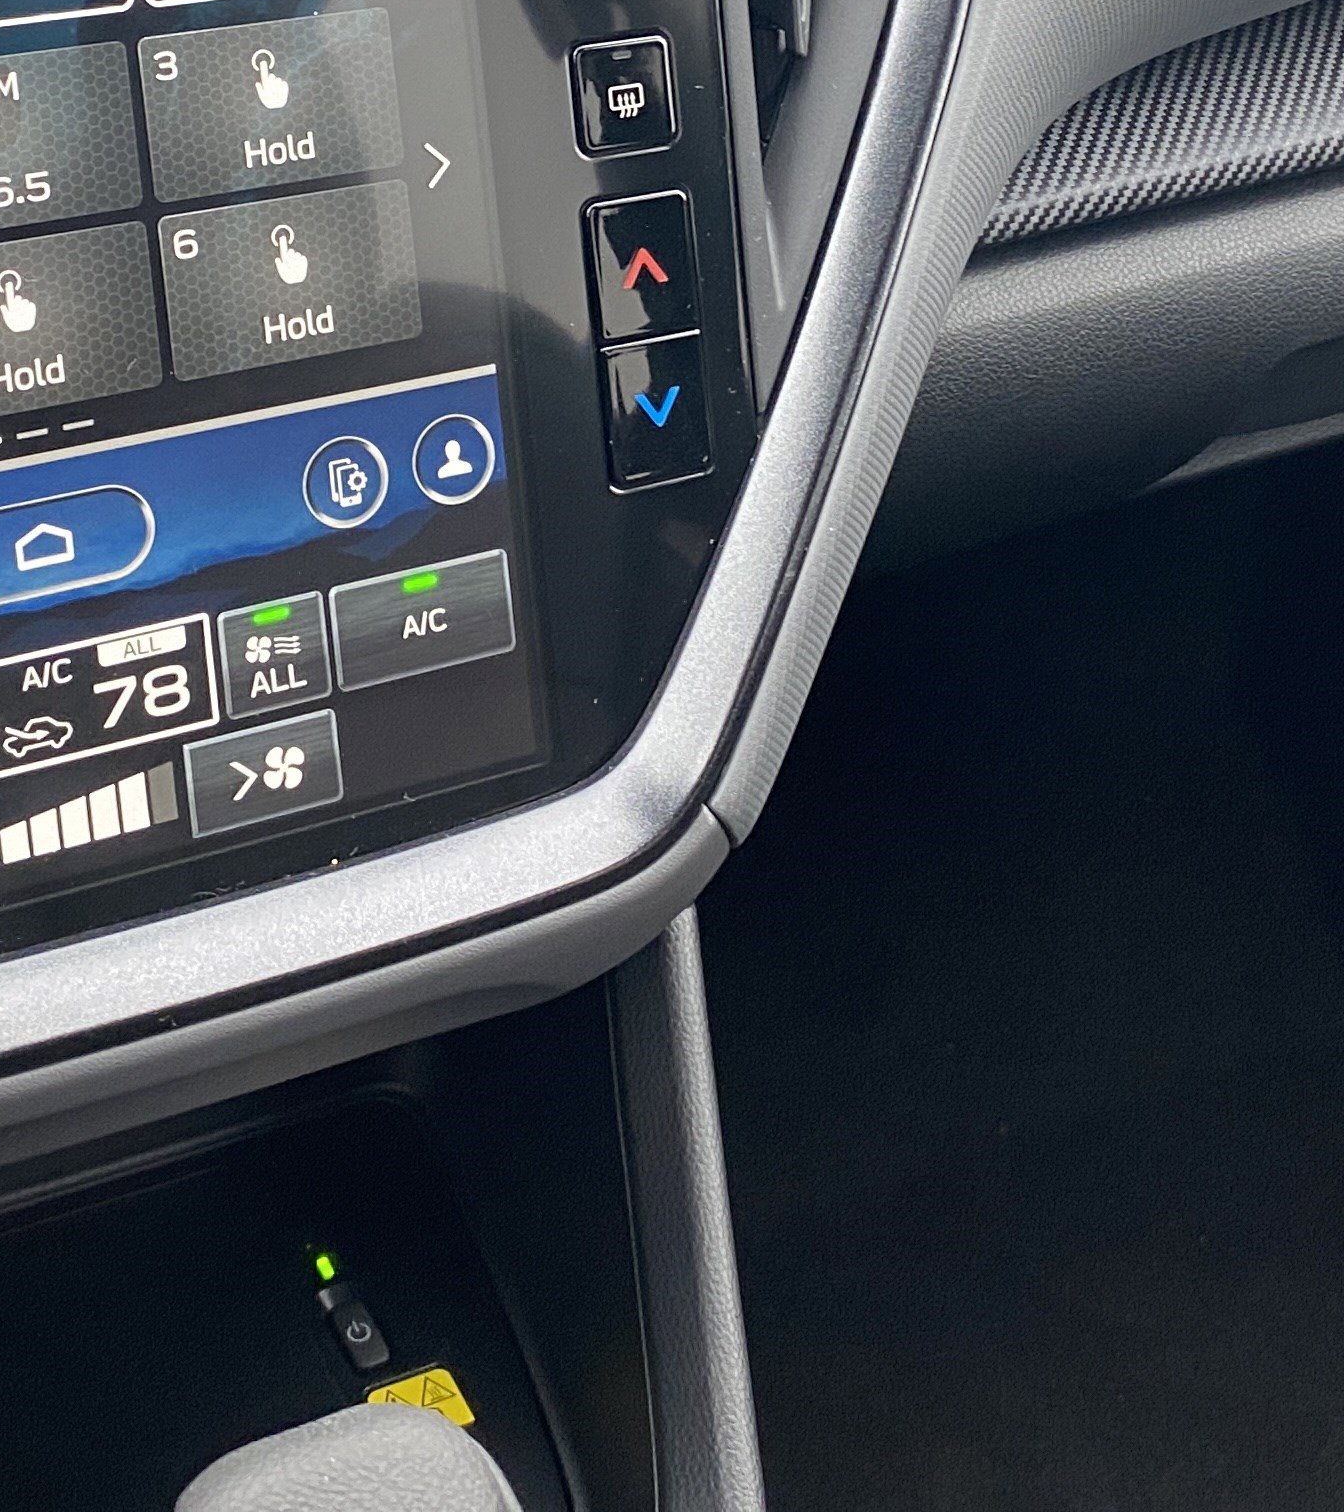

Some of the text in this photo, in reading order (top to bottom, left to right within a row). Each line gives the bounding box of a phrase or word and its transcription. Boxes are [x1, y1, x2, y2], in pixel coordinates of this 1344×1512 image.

[154, 50, 179, 82] 3
[244, 131, 317, 169] Hold
[173, 229, 199, 260] 6
[262, 304, 335, 345] Hold
[402, 607, 448, 640] A/C
[123, 635, 163, 658] ALL
[21, 658, 73, 691] A/C
[250, 663, 308, 698] ALL
[92, 664, 190, 729] 78
